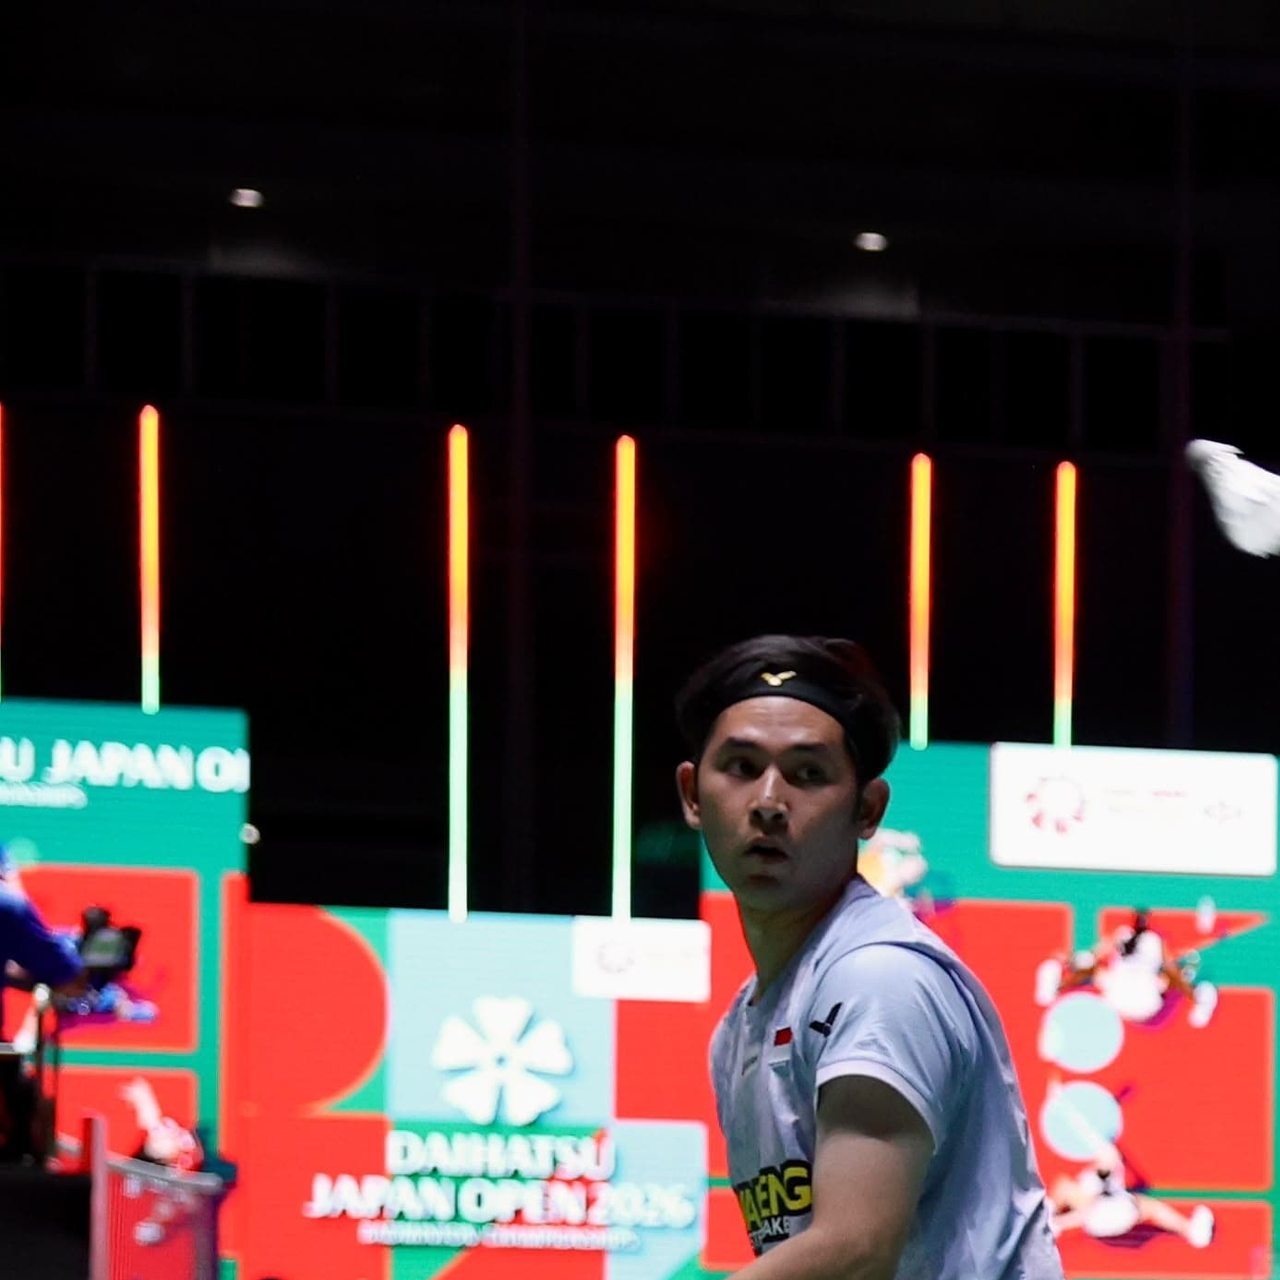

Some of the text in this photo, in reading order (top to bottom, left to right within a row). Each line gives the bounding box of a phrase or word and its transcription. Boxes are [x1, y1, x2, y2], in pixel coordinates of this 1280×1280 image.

[41, 738, 194, 790] JAPAN
[387, 1130, 616, 1180] DAIHATSU
[303, 1173, 456, 1221] JAPAN
[458, 1177, 587, 1224] OPEN
